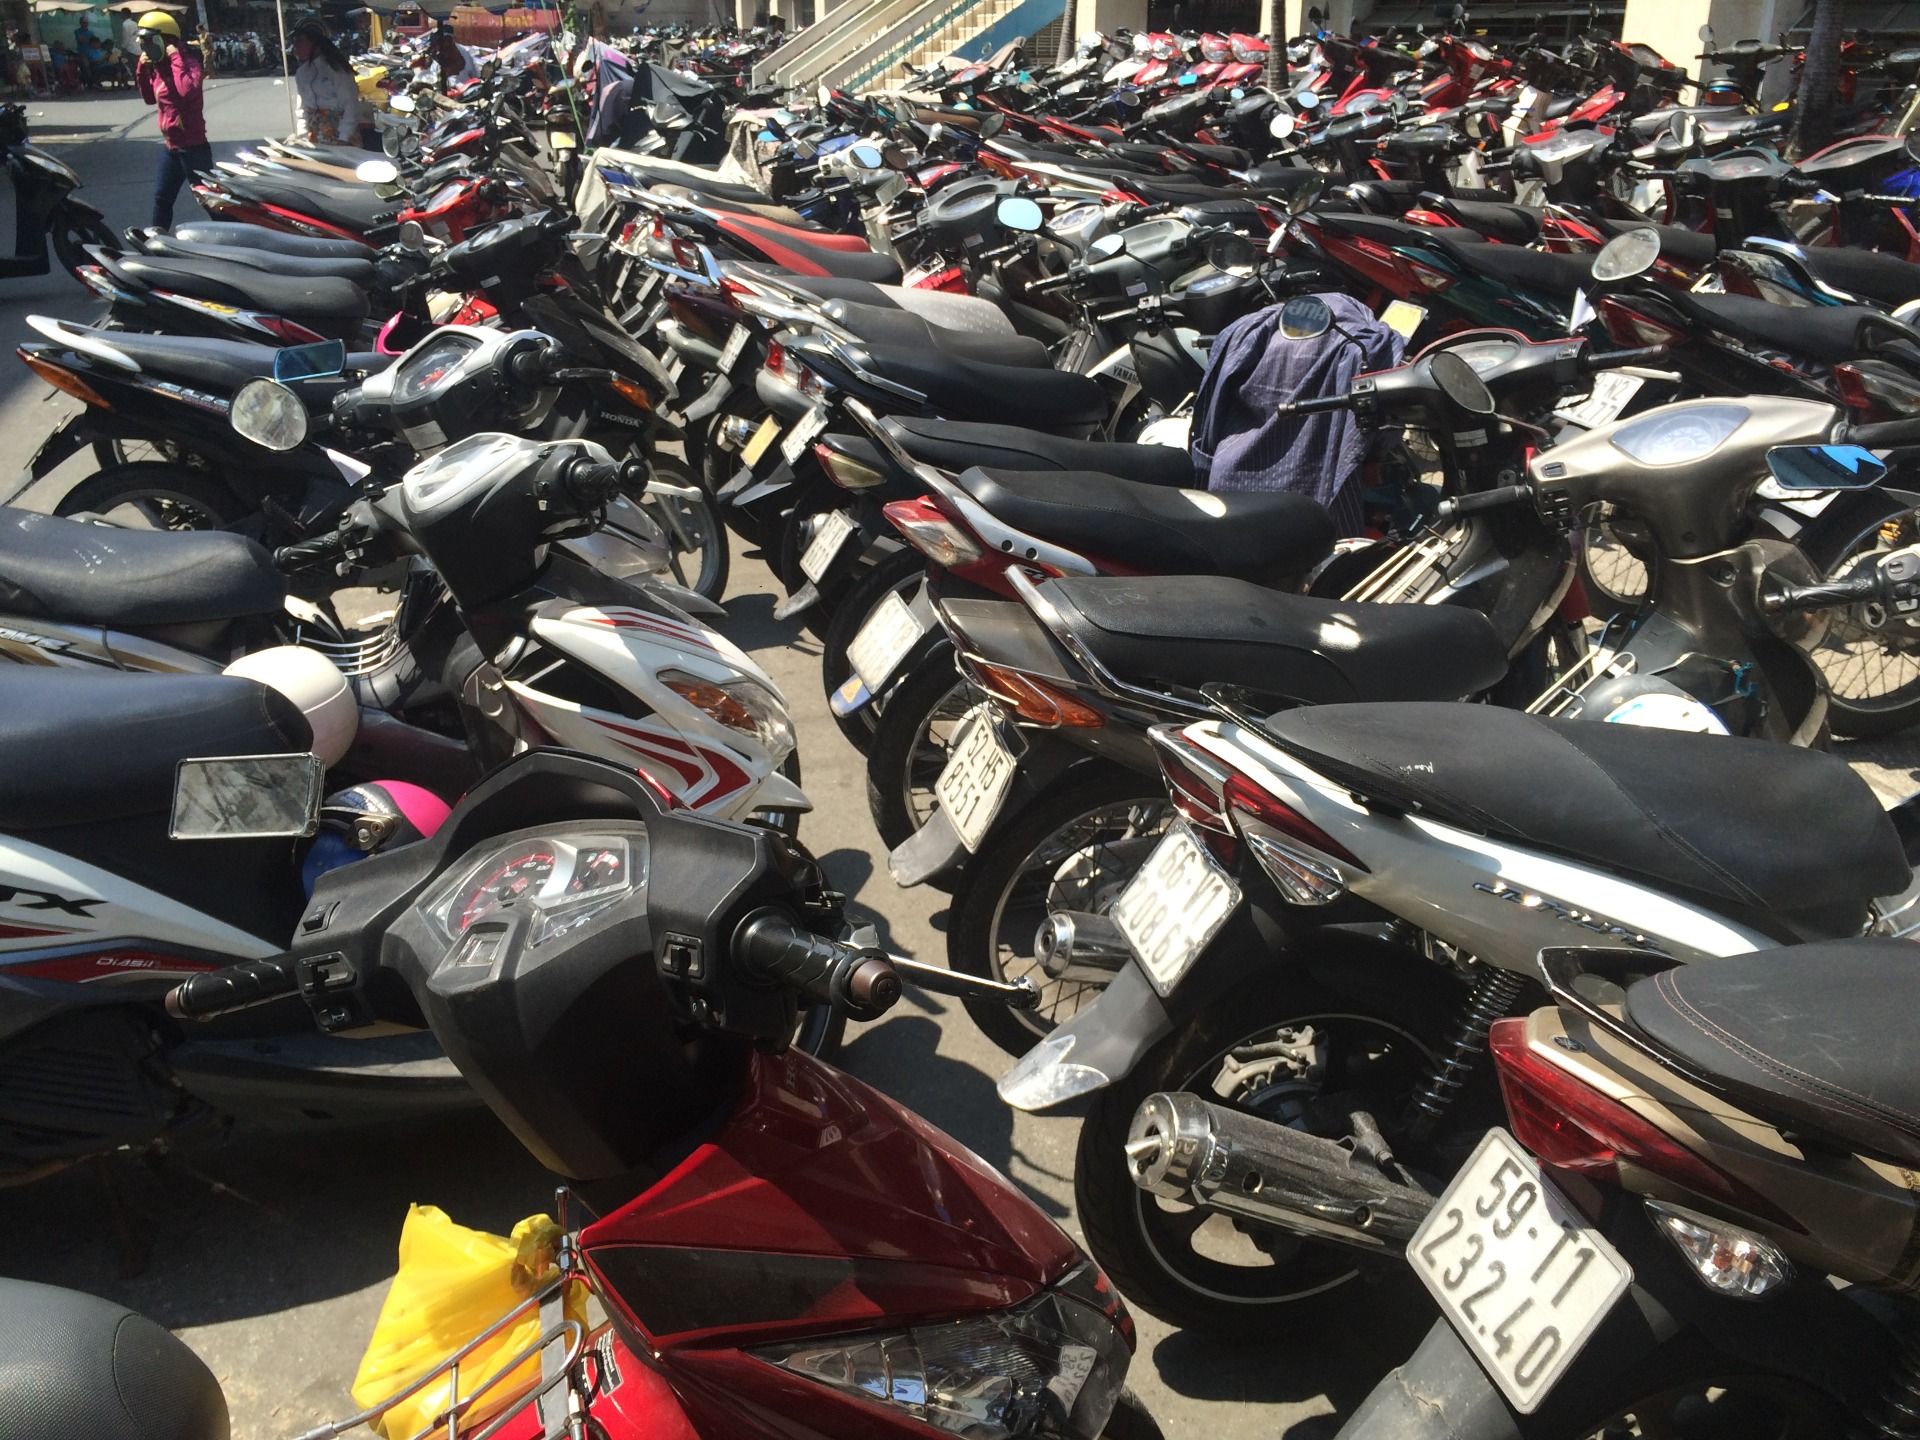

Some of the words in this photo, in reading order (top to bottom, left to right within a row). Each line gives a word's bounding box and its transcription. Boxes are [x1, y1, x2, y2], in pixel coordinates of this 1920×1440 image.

[600, 411, 641, 428] HONDA
[943, 762, 981, 828] 8551
[1420, 1208, 1562, 1387] 232.40
